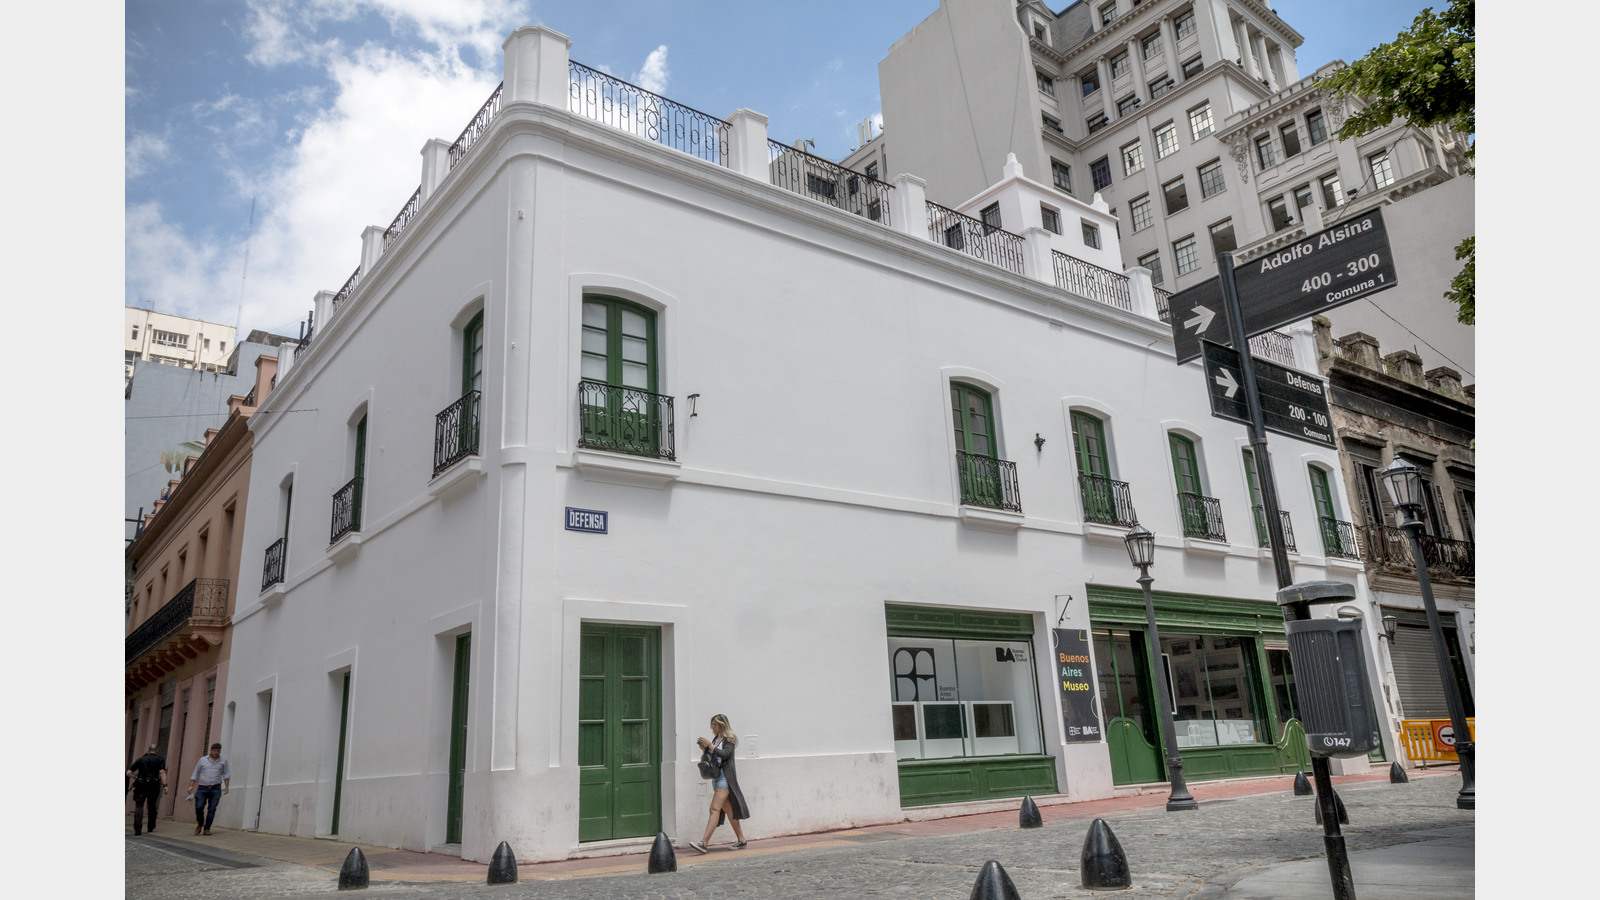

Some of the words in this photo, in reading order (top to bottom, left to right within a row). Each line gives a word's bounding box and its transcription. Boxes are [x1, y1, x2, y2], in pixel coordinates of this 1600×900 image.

[1260, 242, 1313, 273] Adolfo
[1317, 218, 1373, 250] Alsina
[1301, 271, 1332, 294] 400
[1346, 253, 1380, 278] 300
[1325, 279, 1375, 303] Comuna
[1378, 273, 1385, 283] 1
[1286, 371, 1322, 395] Defensa
[1288, 404, 1306, 421] 200
[1312, 411, 1328, 428] 100
[1303, 426, 1326, 442] Comuna
[1327, 433, 1332, 443] 1
[569, 511, 604, 530] DEFENSA
[995, 647, 1015, 663] BA
[1059, 652, 1089, 663] Buenos
[1061, 666, 1083, 677] Aires
[1063, 681, 1089, 691] Museo
[1333, 737, 1351, 747] 147
